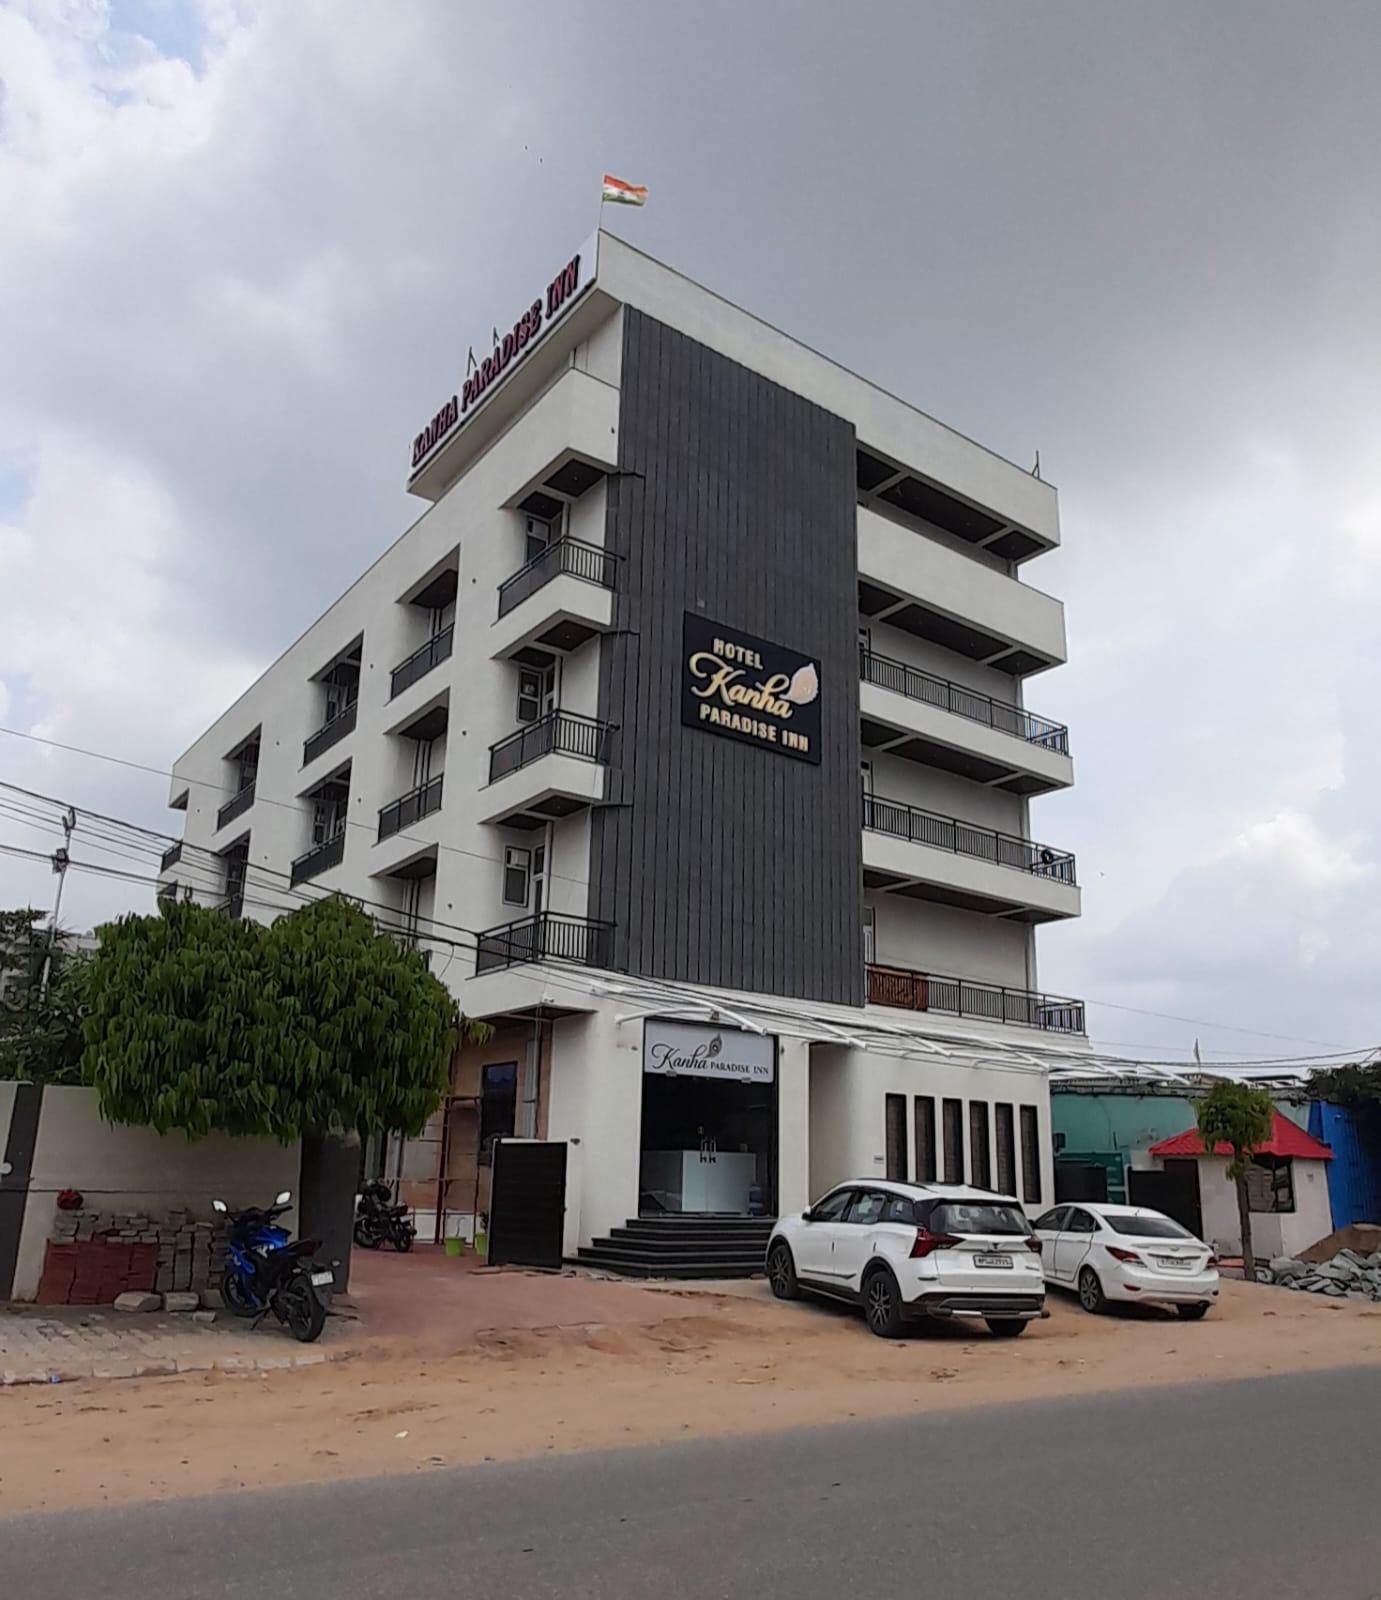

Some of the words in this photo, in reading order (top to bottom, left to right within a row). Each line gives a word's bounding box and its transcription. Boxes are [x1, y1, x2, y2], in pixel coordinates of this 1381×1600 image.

[411, 395, 458, 467] KANHA
[461, 298, 542, 413] PARADISE
[545, 254, 581, 319] INN
[713, 638, 763, 670] HOTEL
[689, 652, 793, 719] Kanha
[700, 703, 777, 742] PARADISE
[782, 730, 809, 752] INN
[651, 1043, 707, 1070] Kanha
[710, 1061, 750, 1073] PARADISE
[753, 1066, 769, 1075] INN
